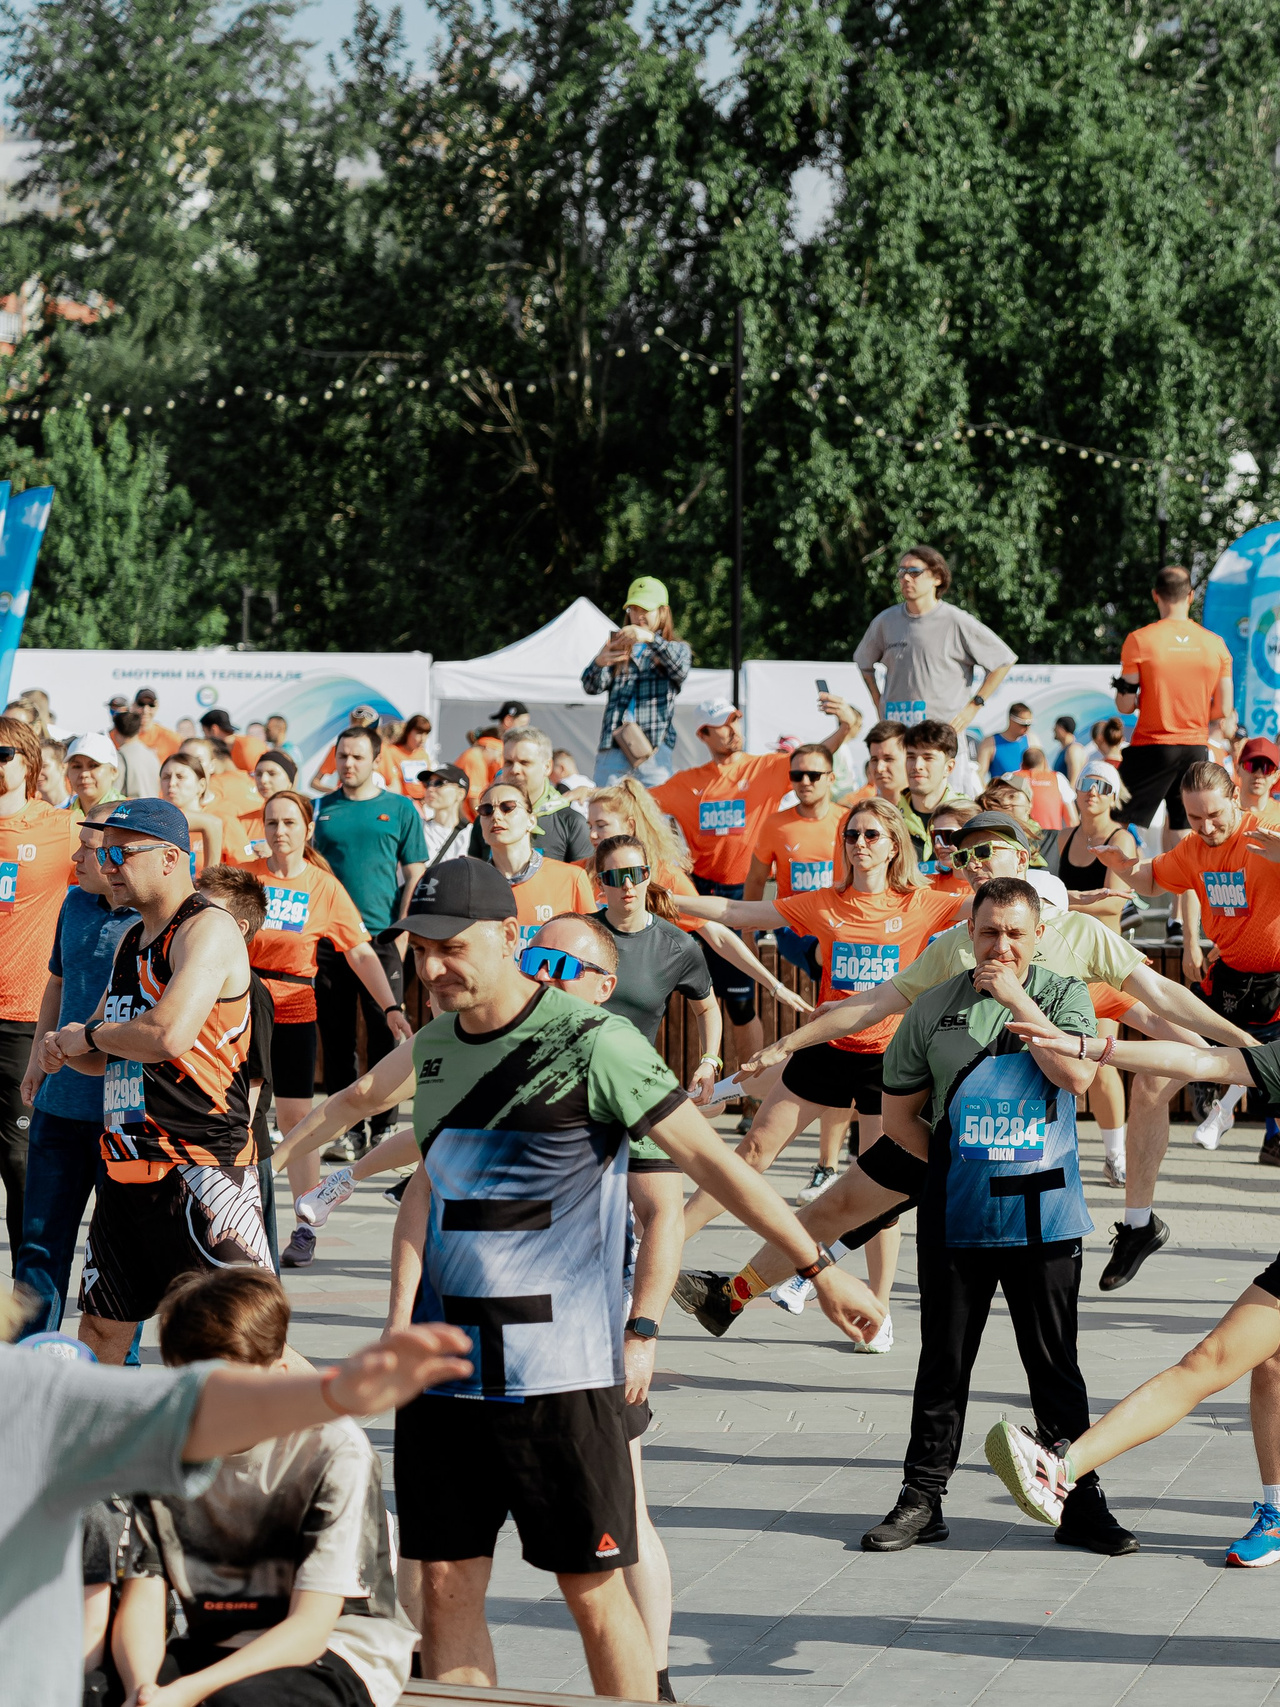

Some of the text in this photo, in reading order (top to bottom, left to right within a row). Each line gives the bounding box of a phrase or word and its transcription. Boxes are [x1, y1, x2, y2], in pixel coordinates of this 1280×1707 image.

[112, 667, 304, 681] СМОТРИМ НА ТЕЛЕКАНАЛЕ
[16, 843, 37, 862] 10
[1207, 883, 1246, 907] 30096
[534, 904, 554, 921] 10
[883, 916, 903, 934] 10
[835, 955, 895, 981] 50253
[104, 1076, 140, 1112] 50298
[996, 1101, 1011, 1115] 10
[964, 1115, 1040, 1147] 50284
